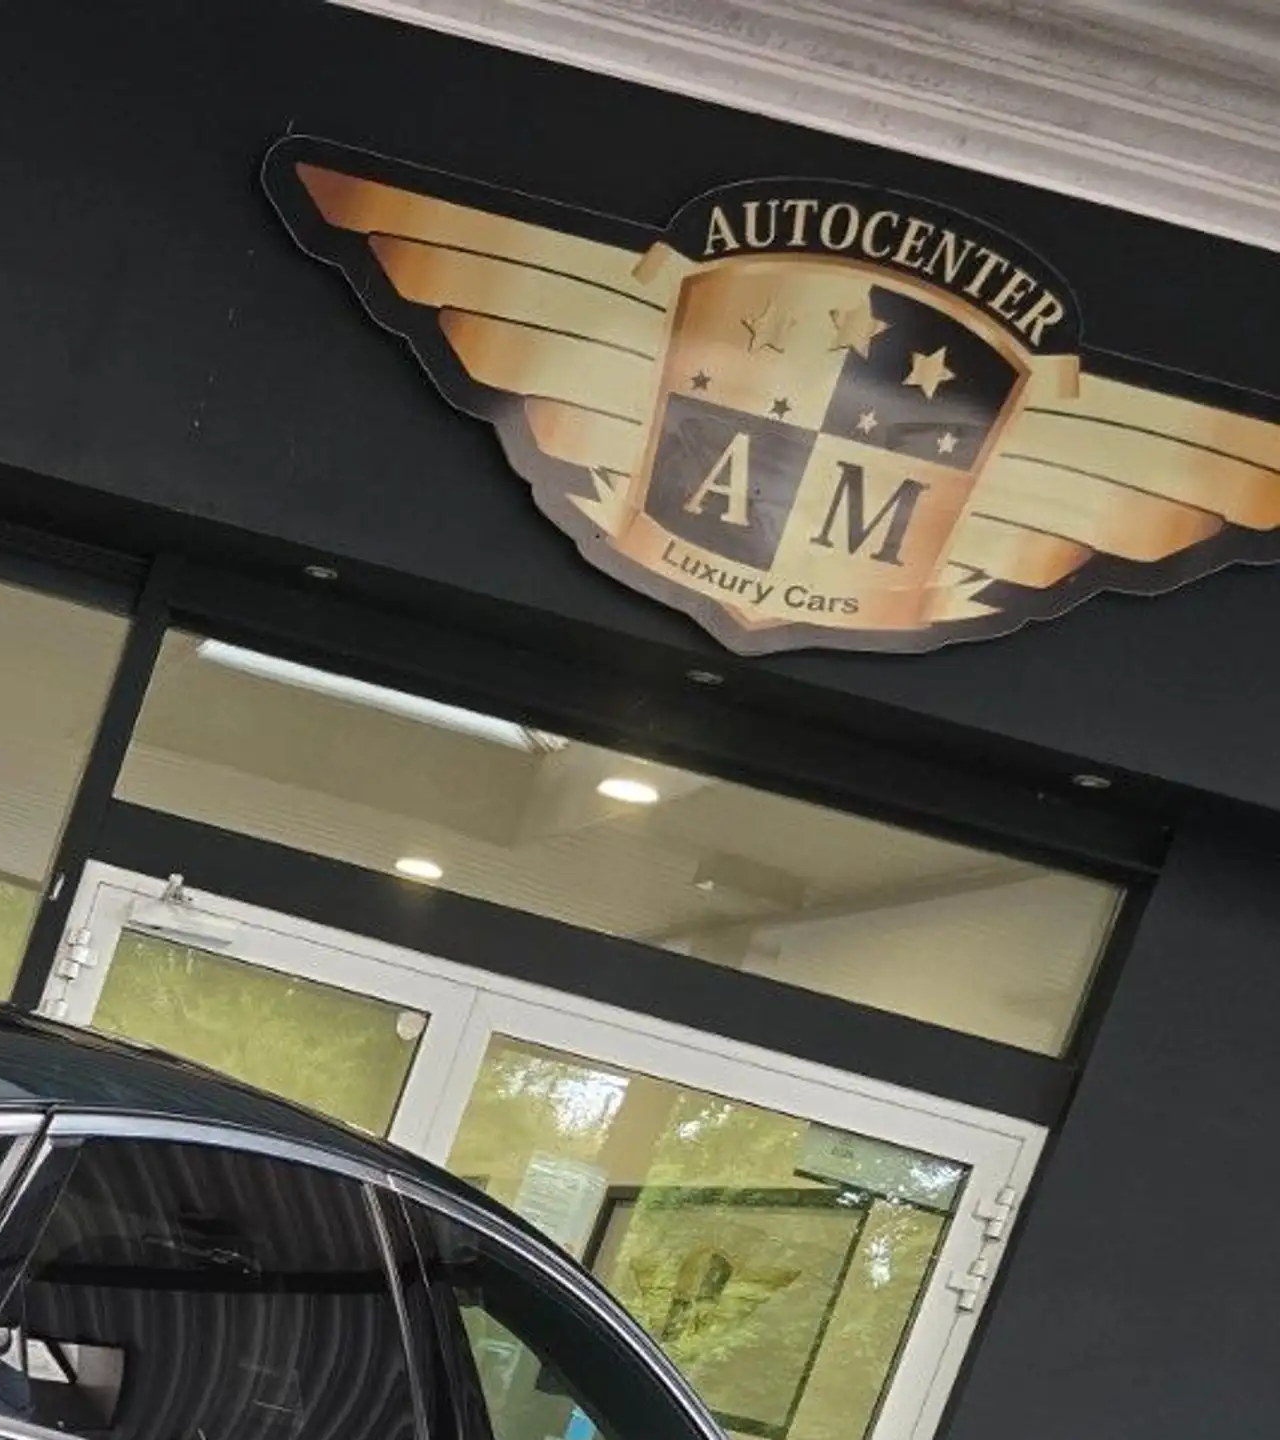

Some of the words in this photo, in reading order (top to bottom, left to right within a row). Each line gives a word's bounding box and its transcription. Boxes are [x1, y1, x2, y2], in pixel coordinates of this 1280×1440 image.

[703, 198, 1065, 348] AUTOCENTER
[661, 540, 775, 605] Luxury
[784, 585, 861, 615] Cars
